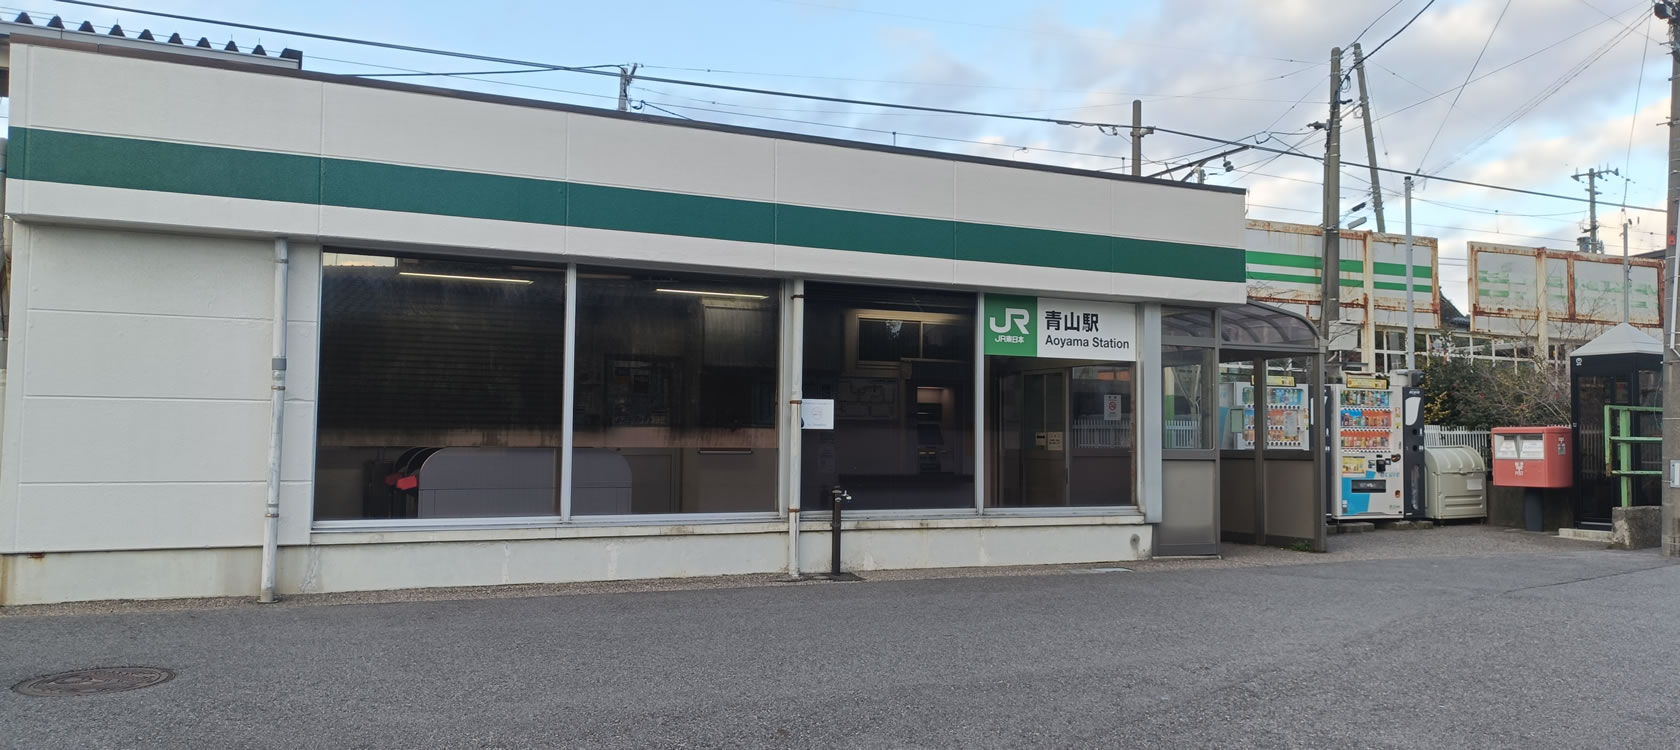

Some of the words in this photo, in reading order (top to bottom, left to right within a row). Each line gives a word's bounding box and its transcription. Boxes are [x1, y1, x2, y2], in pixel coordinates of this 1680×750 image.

[989, 307, 1030, 335] JR
[1045, 310, 1099, 332] 青山駅
[994, 335, 1025, 344] JR東日本
[1045, 334, 1089, 348] Aoyama
[1092, 336, 1130, 349] Station
